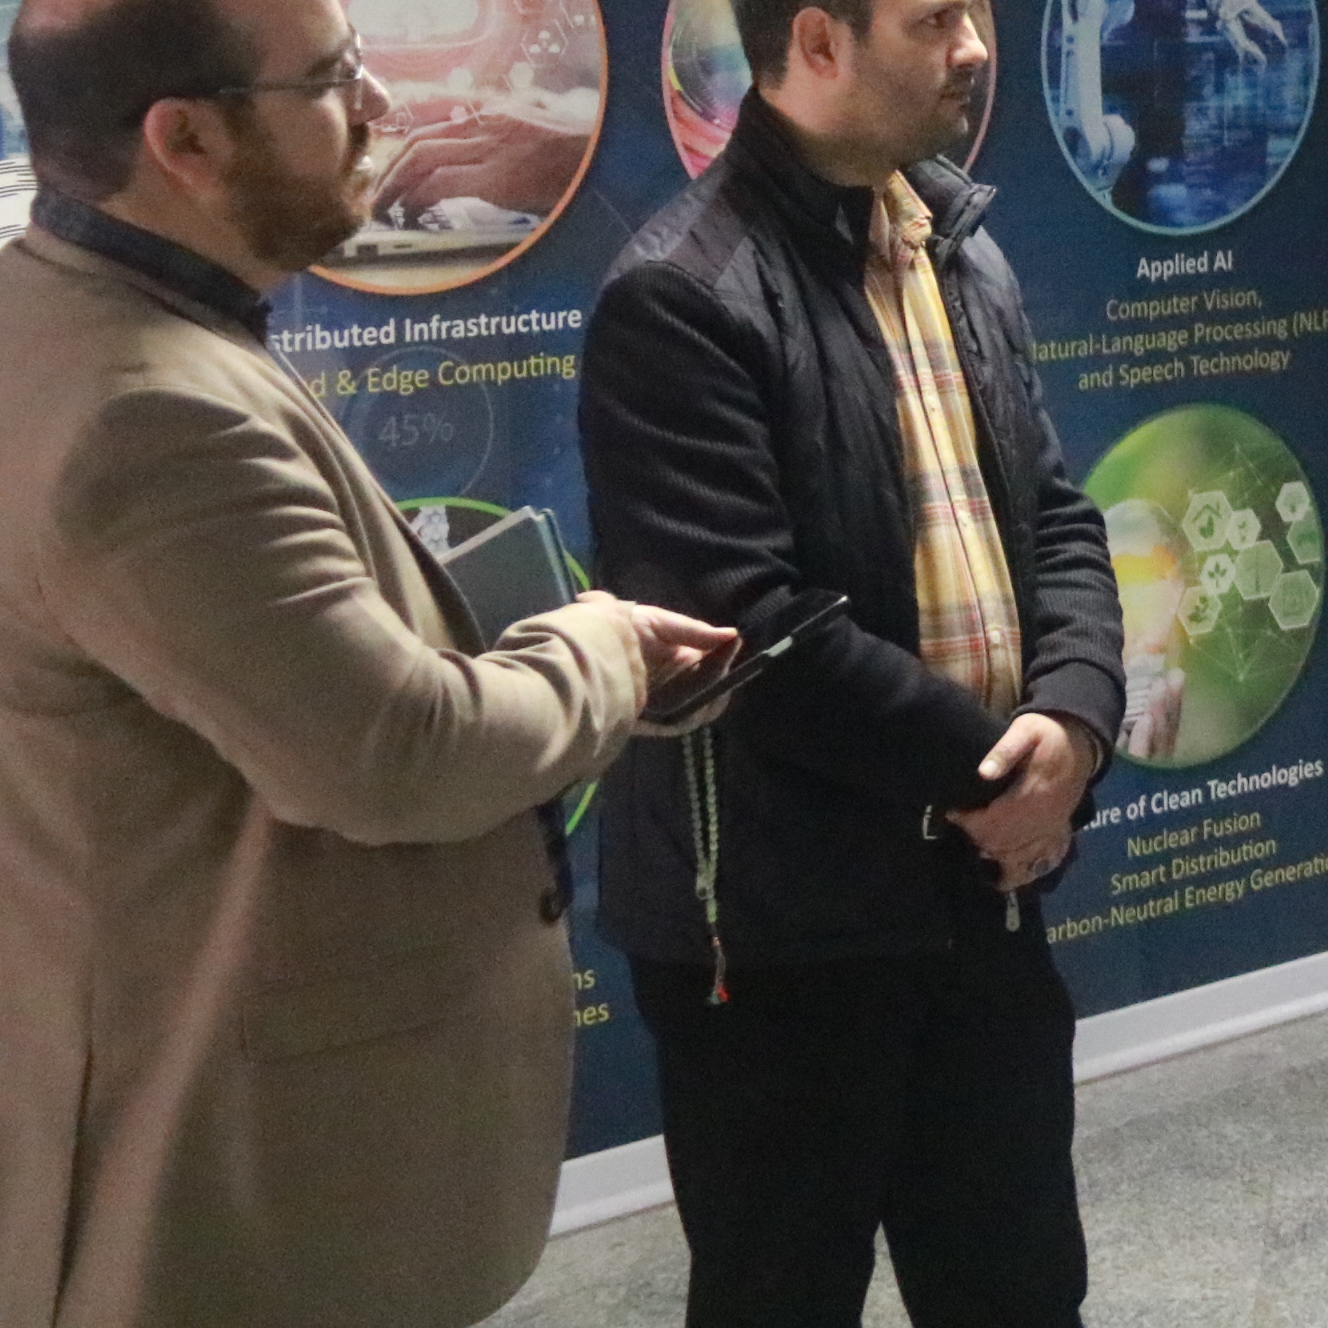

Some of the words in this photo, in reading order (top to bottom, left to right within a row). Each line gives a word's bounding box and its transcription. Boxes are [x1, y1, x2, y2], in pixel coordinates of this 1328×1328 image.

[1136, 250, 1208, 282] Applied
[1213, 249, 1234, 271] AI
[1106, 294, 1198, 322] Computer
[1204, 288, 1263, 310] Vision,
[404, 308, 582, 343] Infrastructure
[1194, 316, 1288, 346] Processing
[336, 369, 357, 395] &
[367, 365, 429, 396] Edge
[438, 352, 576, 386] Computing
[1078, 367, 1113, 391] and
[1119, 358, 1185, 388] Speech
[1191, 347, 1292, 377] Technology
[377, 413, 454, 448] 45%
[1083, 808, 1121, 831] ure
[1127, 794, 1147, 820] of
[1151, 787, 1202, 815] Clean
[1207, 759, 1324, 802] Technologies
[1127, 824, 1199, 859] Nuclear
[1203, 810, 1262, 840] Fusion
[1111, 863, 1166, 896] Smart
[1172, 837, 1277, 881] Distribution
[1185, 875, 1245, 908] Energy
